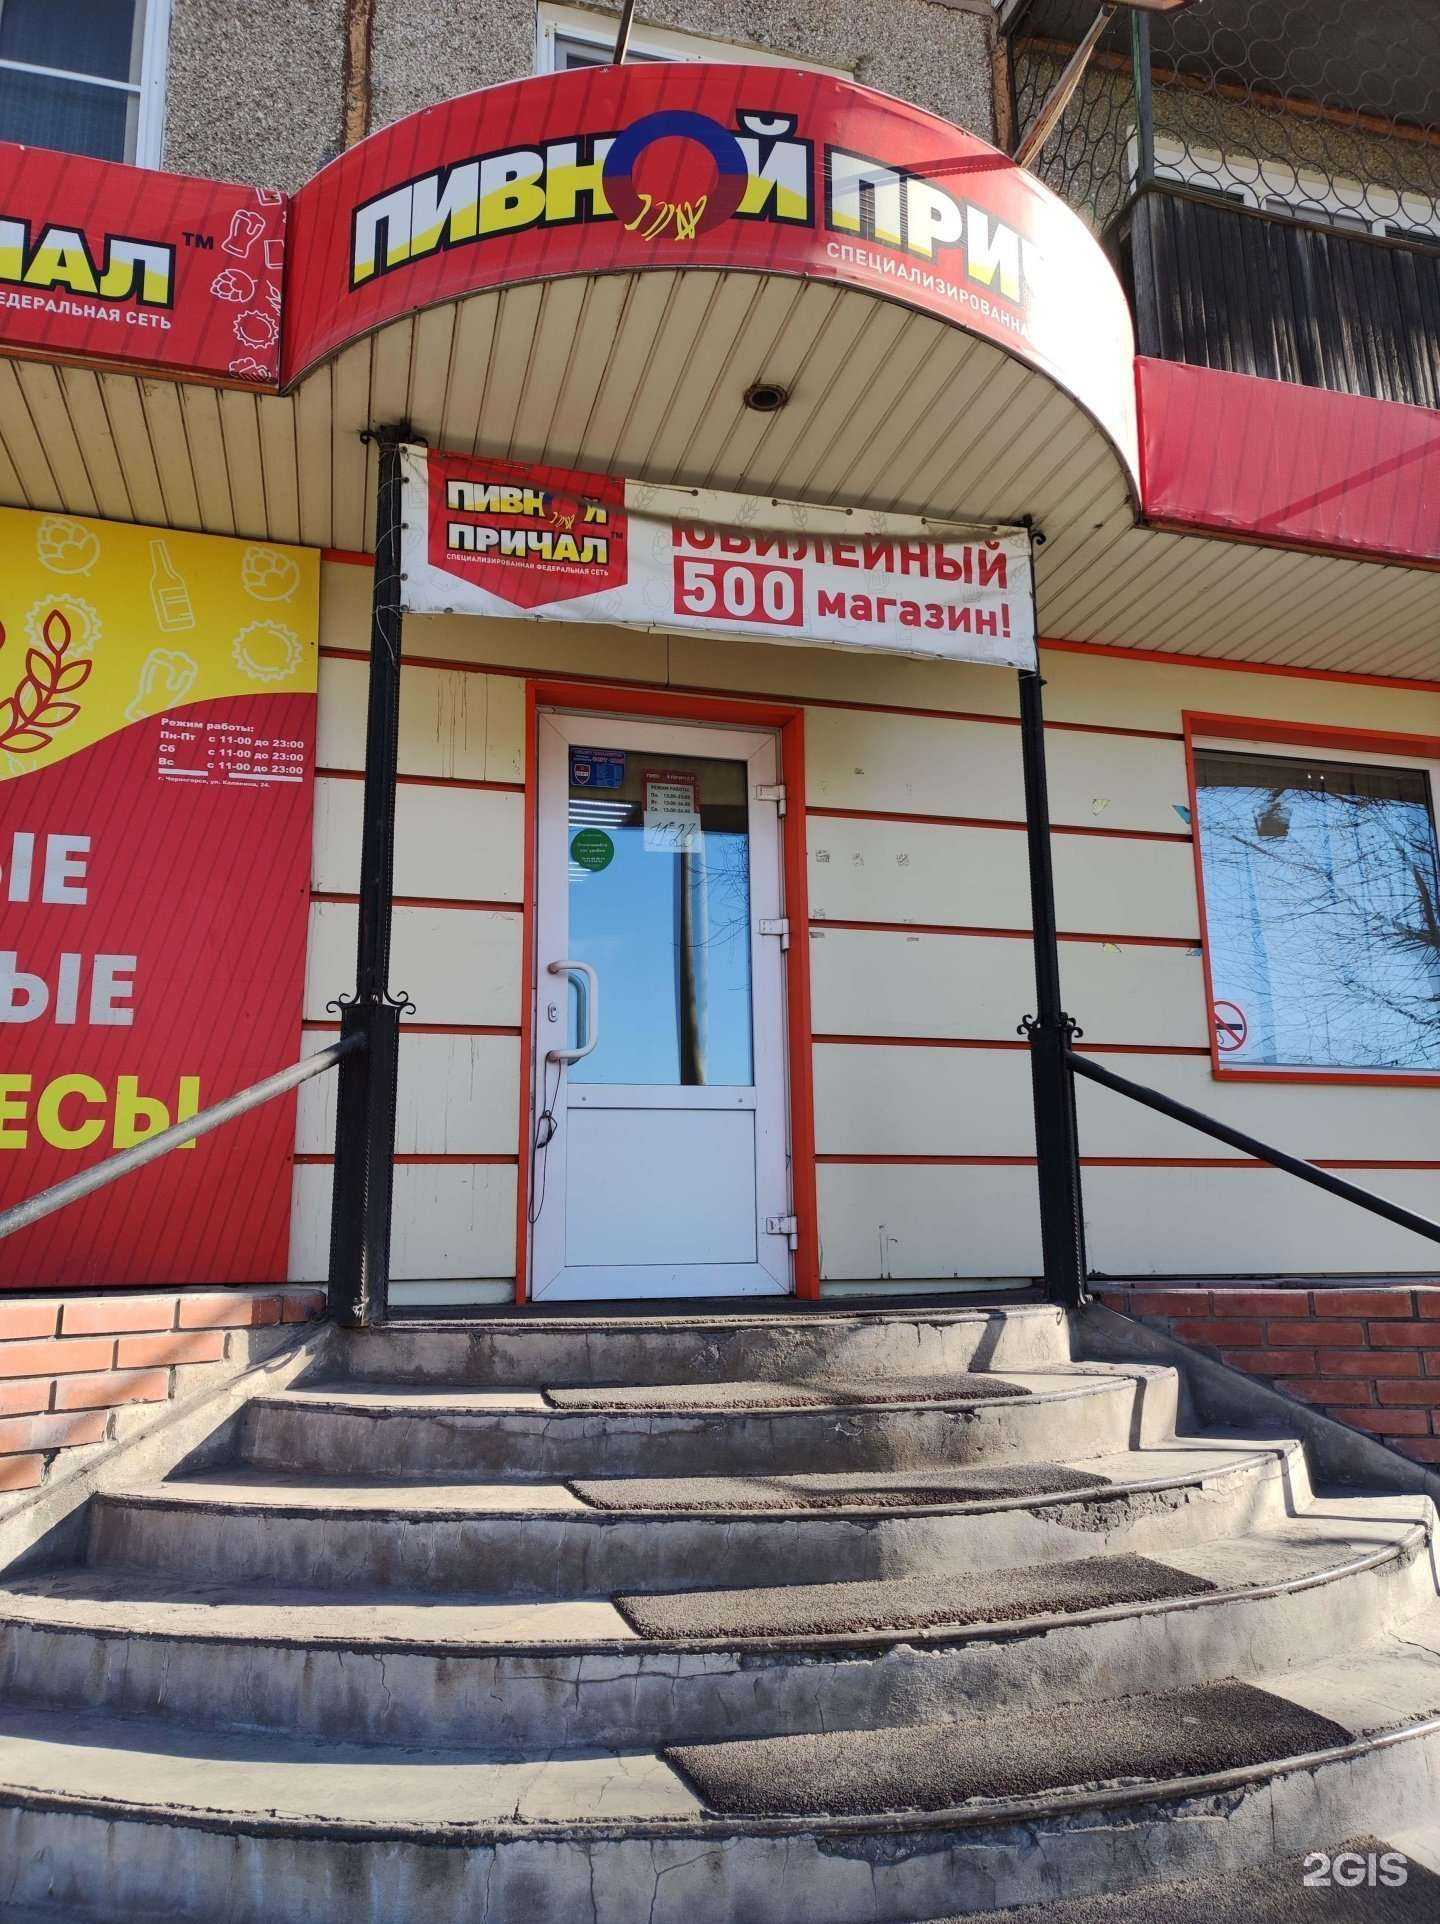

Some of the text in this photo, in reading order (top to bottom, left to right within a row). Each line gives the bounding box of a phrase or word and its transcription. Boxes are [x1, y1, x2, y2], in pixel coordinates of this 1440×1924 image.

[350, 109, 1038, 308] ПИВНОЙ ПРИ
[826, 242, 1034, 339] СПЕЦИАЛИЗИРОВАННА
[126, 311, 172, 330] СЕТЬ
[447, 521, 609, 565] ПРИЧАЛ
[672, 520, 1007, 589] ЮБИЛЕЙНЫЙ
[447, 553, 608, 577] СПЕЦИАЛИЗИРОВАННАЯ ФЕДЕРАЛЬНАЯ СЕТЬ
[682, 560, 1011, 638] 500 магазин!
[161, 717, 254, 733] Режим работы:
[160, 731, 196, 741] Пн-Пт
[220, 735, 251, 745] 11-00
[254, 739, 269, 747] до
[272, 739, 304, 749] 23:00
[159, 744, 176, 753] Сб
[219, 748, 251, 758] 11-00
[254, 752, 269, 760] до
[272, 752, 304, 761] 23:00
[158, 757, 175, 766] Вс
[218, 761, 250, 771] 11-00
[253, 764, 268, 773] до
[272, 765, 303, 774] 23:00
